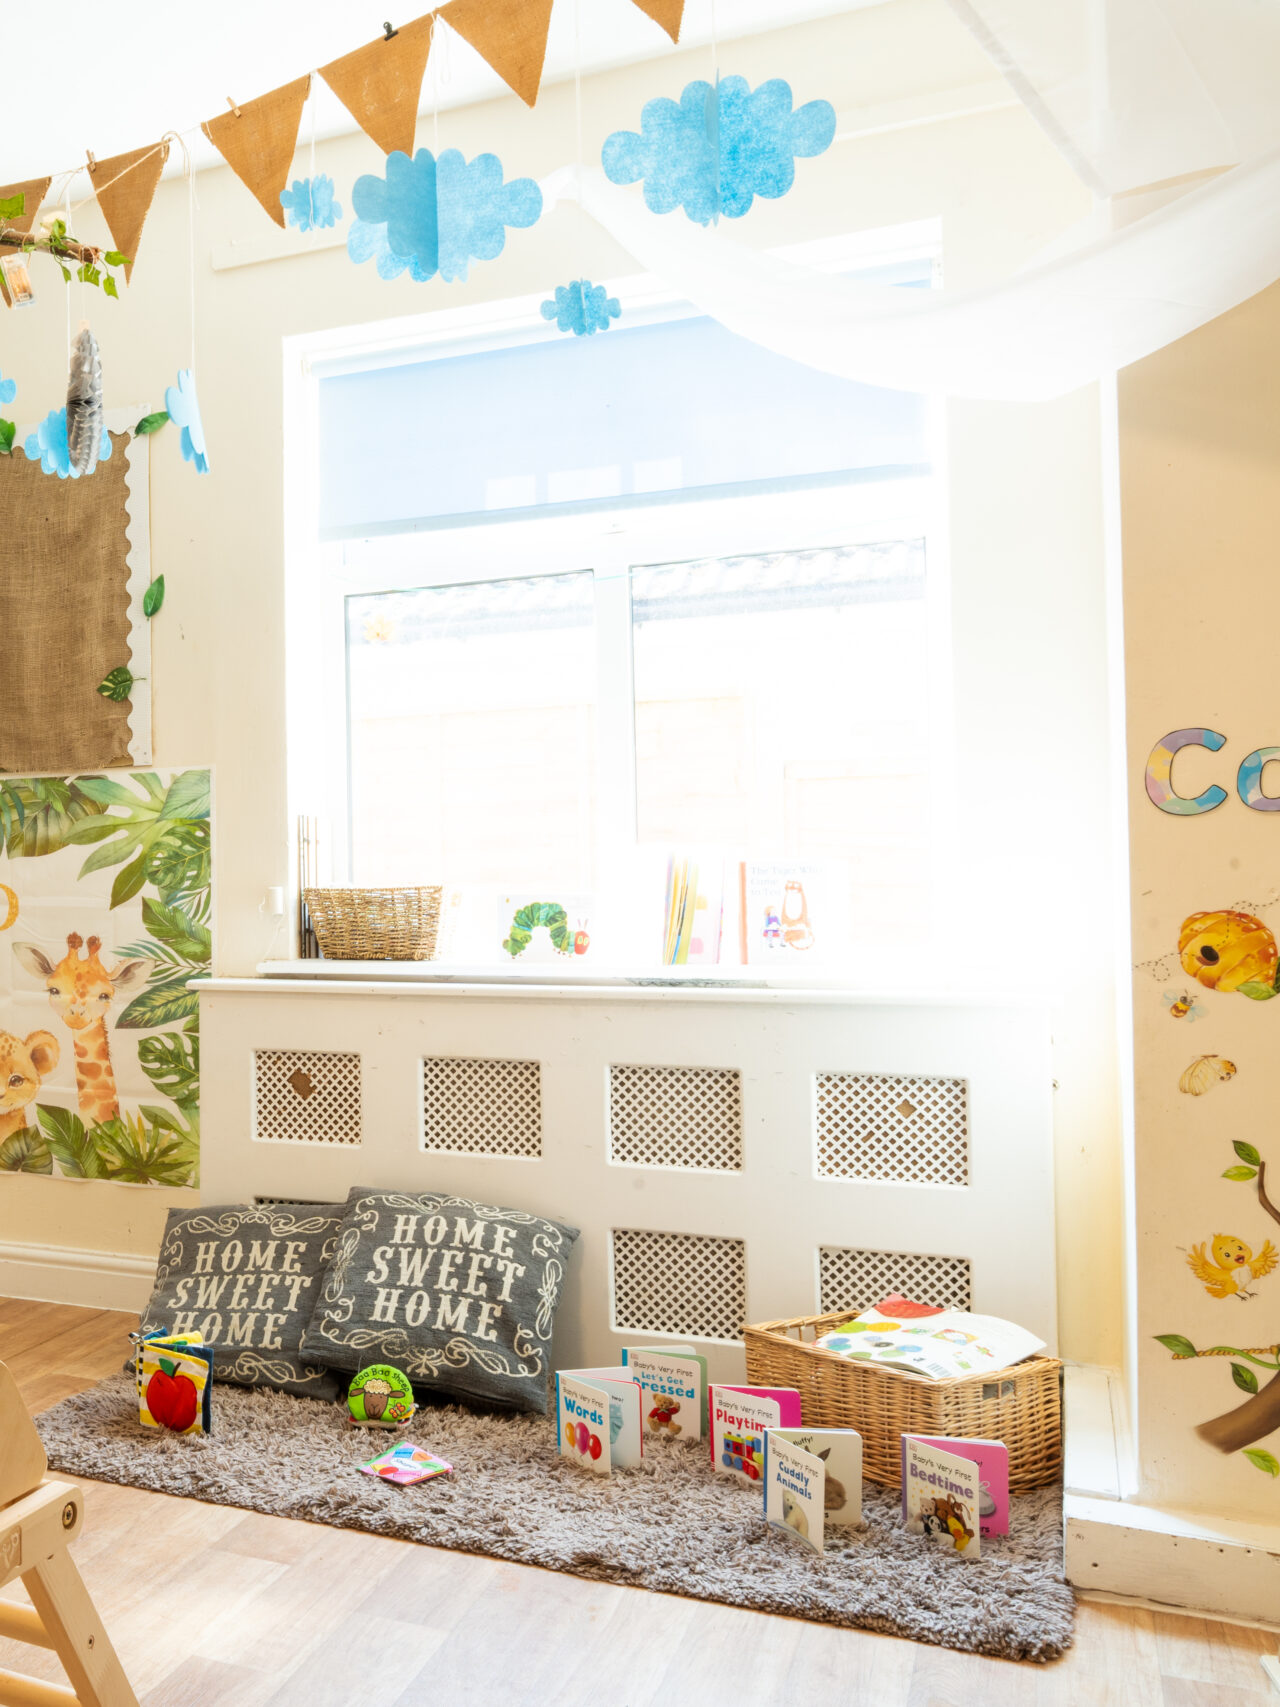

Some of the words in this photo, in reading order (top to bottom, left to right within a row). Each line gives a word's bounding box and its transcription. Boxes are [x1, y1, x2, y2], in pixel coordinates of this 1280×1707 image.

[389, 1214, 518, 1259] HOME
[192, 1240, 308, 1275] HOME
[365, 1246, 526, 1303] SWEET
[166, 1273, 313, 1312] SWEET
[369, 1287, 503, 1342] HOME
[171, 1311, 288, 1350] HOME
[353, 1371, 370, 1386] Baa
[371, 1368, 390, 1376] Baa
[634, 1360, 656, 1371] Baby's
[658, 1366, 674, 1375] Very
[677, 1368, 694, 1378] First
[641, 1371, 663, 1382] Let's
[667, 1376, 684, 1386] Get
[564, 1395, 604, 1426] Words
[716, 1408, 774, 1433] Playtim
[718, 1399, 739, 1411] Baby's
[740, 1405, 756, 1415] Very
[757, 1409, 773, 1419] First
[779, 1461, 809, 1486] Cuddly
[910, 1463, 974, 1499] Bedtime
[912, 1453, 935, 1467] Baby's
[936, 1462, 953, 1474] Very
[955, 1469, 972, 1481] First
[777, 1473, 812, 1500] Animals
